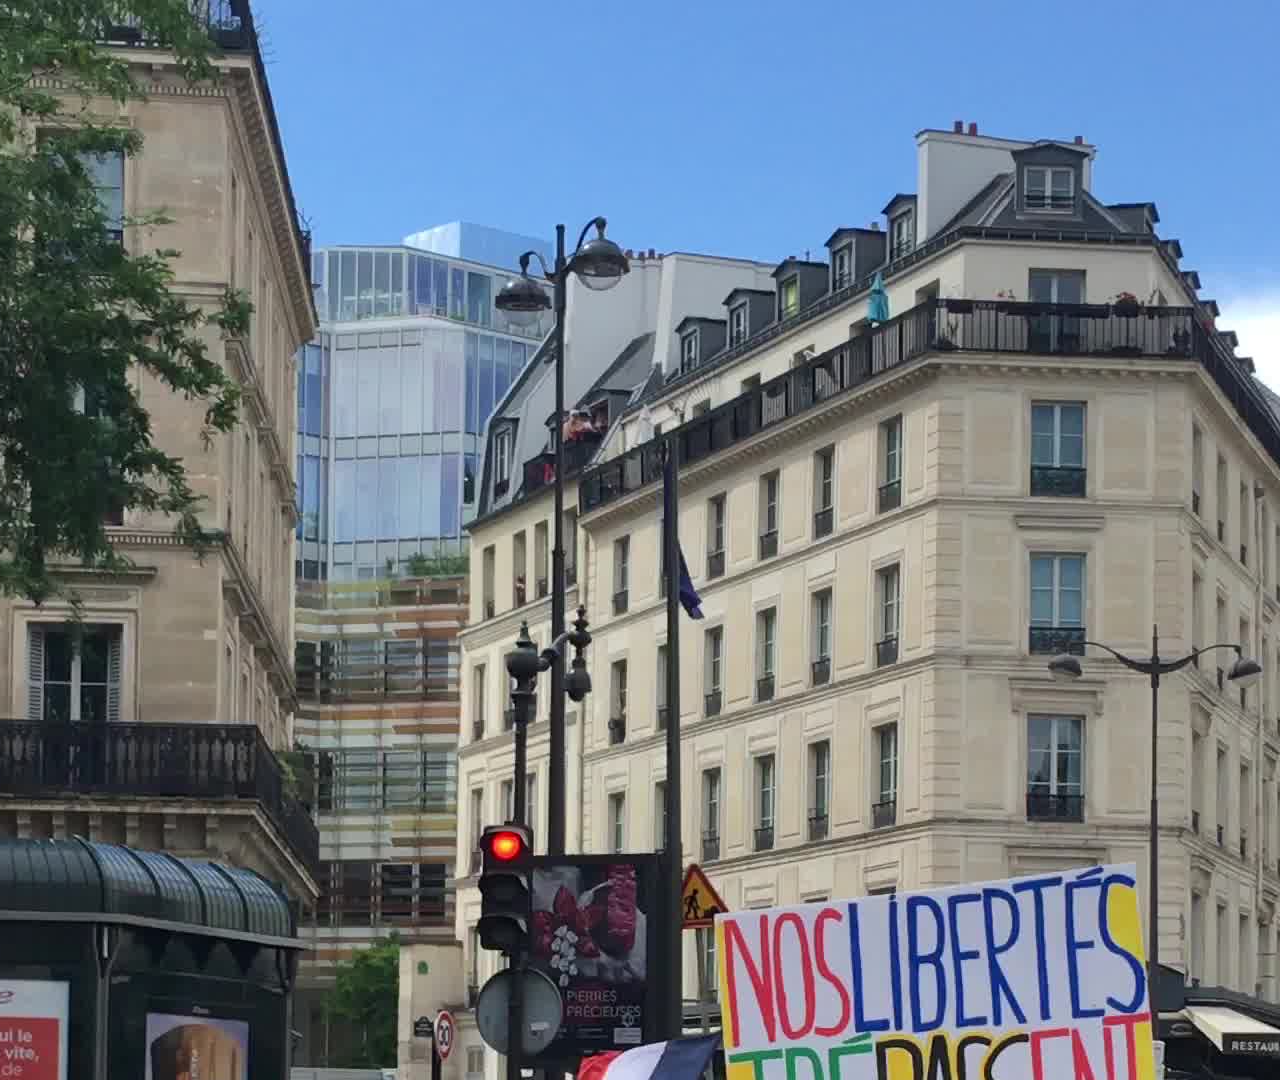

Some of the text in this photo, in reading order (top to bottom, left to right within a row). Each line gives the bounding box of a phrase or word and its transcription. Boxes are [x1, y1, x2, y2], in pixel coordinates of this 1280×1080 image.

[722, 867, 1147, 1047] NOS LIBERTÉS
[567, 990, 617, 1001] PIERRES
[567, 1004, 641, 1017] PRÉCIEUSES
[18, 1029, 33, 1042] le
[4, 1047, 39, 1062] vite,
[1, 1062, 23, 1076] de
